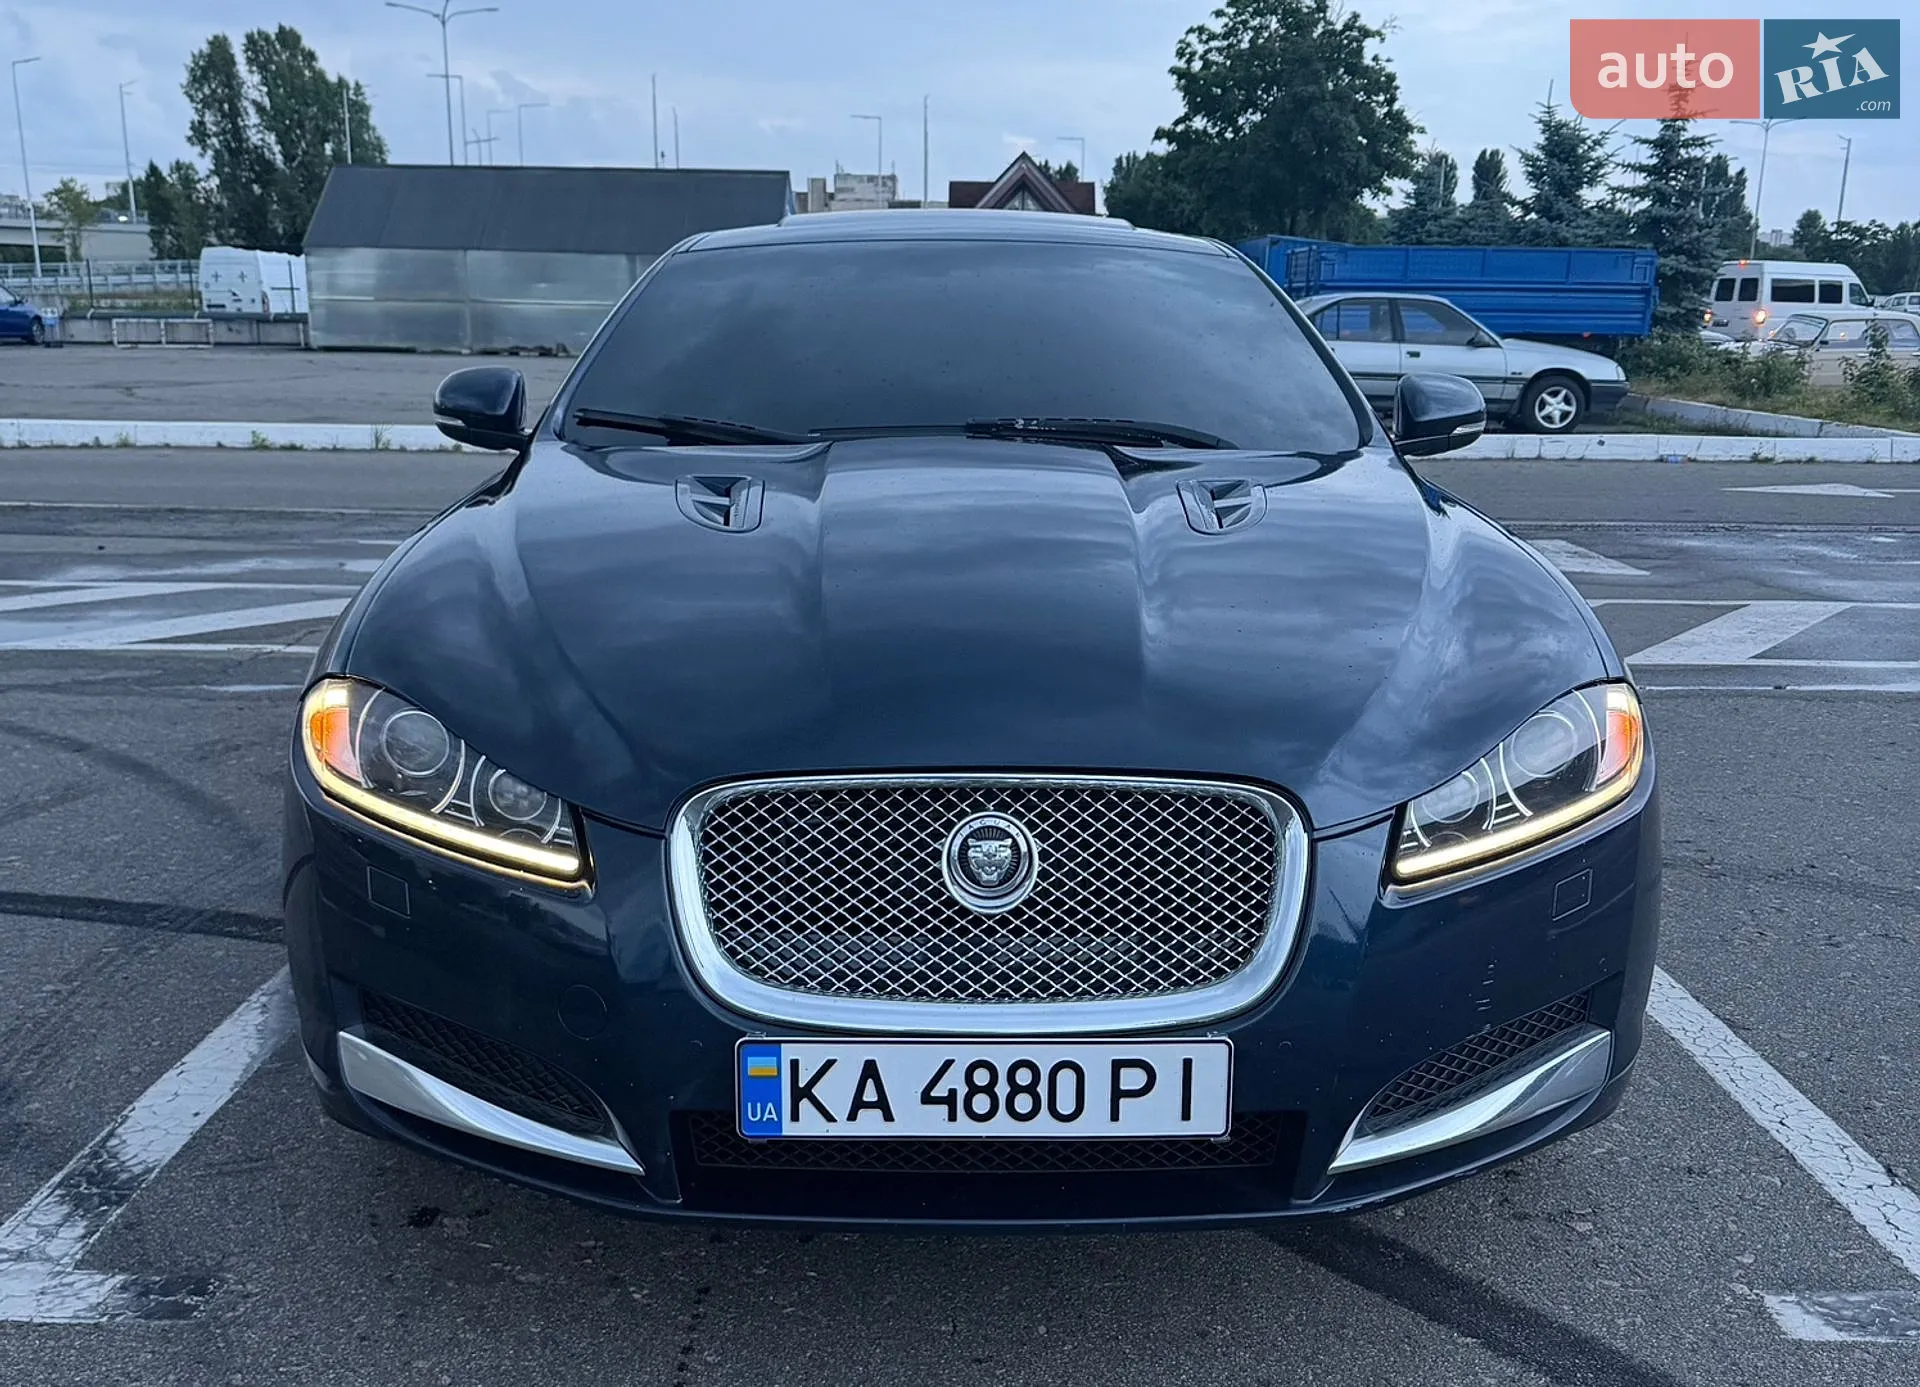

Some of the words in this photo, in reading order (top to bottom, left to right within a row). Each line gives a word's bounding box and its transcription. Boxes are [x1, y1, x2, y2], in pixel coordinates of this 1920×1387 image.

[789, 1058, 896, 1123] KA
[919, 1058, 1086, 1123] 4880
[747, 1102, 778, 1122] UA
